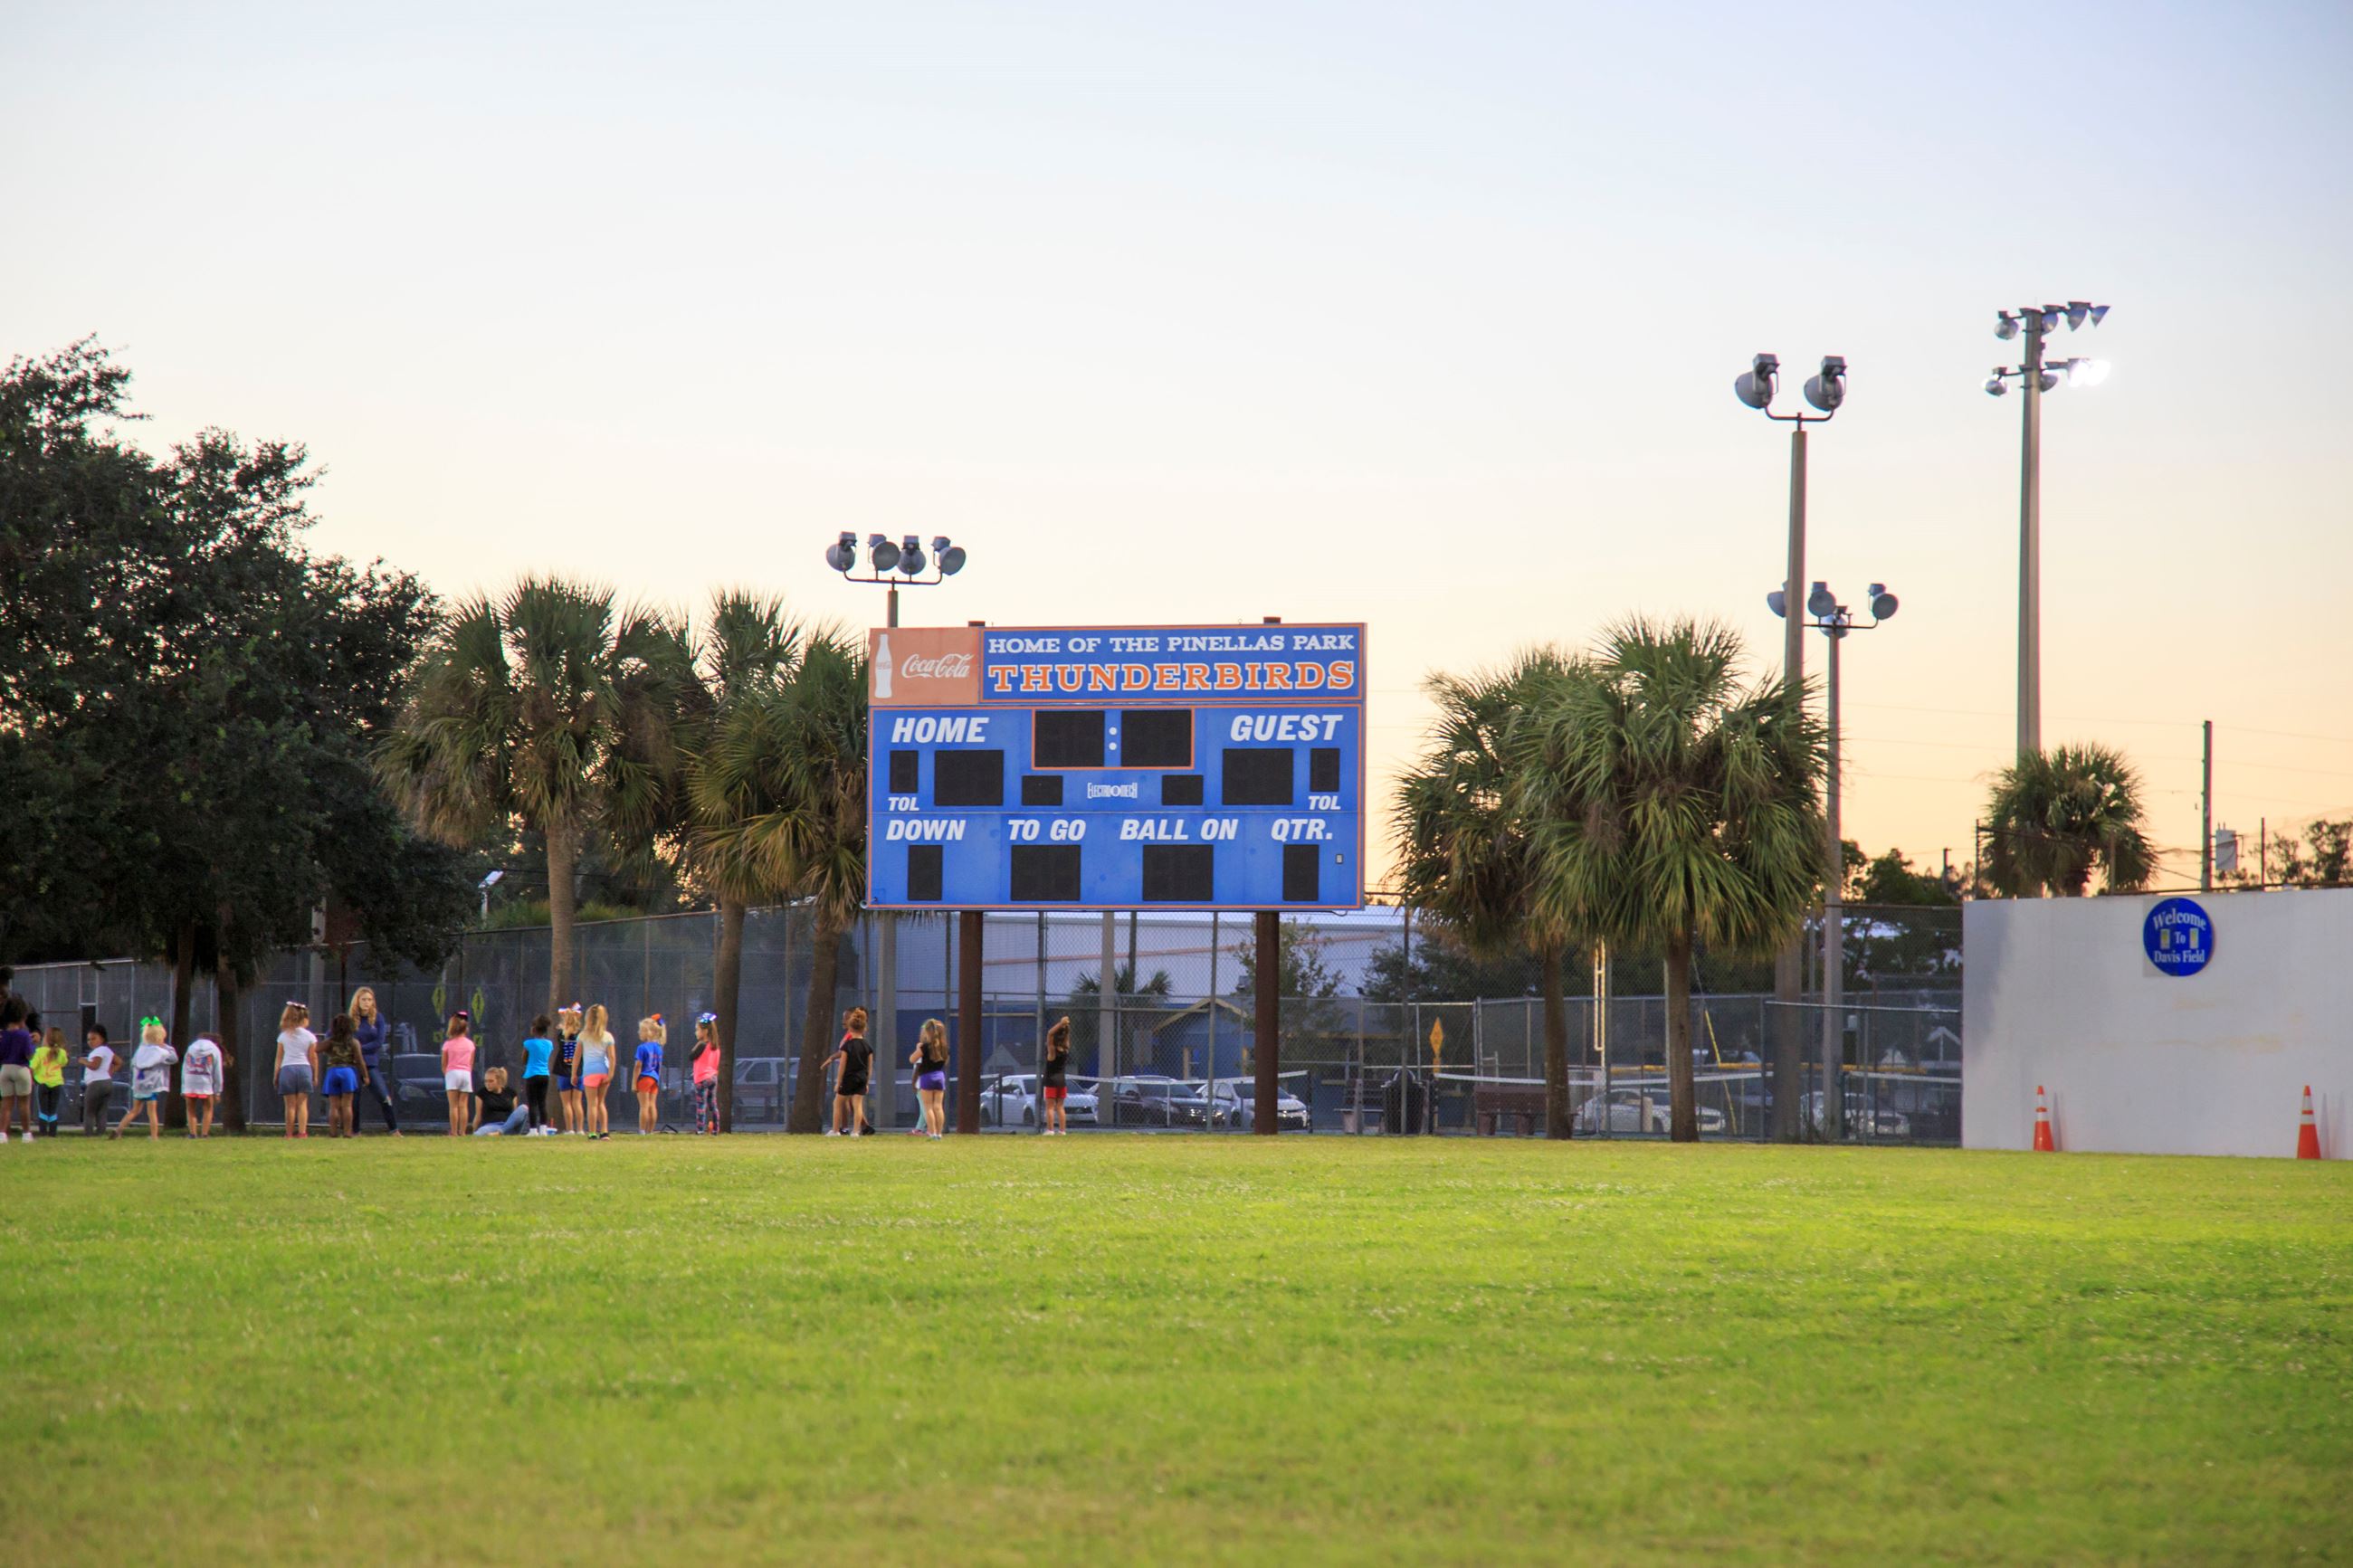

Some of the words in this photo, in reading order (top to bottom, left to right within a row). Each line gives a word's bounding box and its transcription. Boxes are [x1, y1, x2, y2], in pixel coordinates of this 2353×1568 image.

[988, 637, 1060, 653] HOME
[1068, 637, 1100, 652] OF
[1110, 637, 1159, 652] THE
[1167, 635, 1285, 651] PINELLAS
[1292, 634, 1355, 651] PARK
[988, 660, 1354, 692] THUNDERBIRDS
[891, 717, 989, 743] HOME
[1230, 714, 1344, 741] GUEST
[888, 796, 919, 812] TOL
[1308, 795, 1341, 810] TOL
[886, 819, 966, 841] DOWN
[1008, 819, 1040, 841] TO
[1050, 819, 1086, 841] GO
[1119, 819, 1189, 840] BALL
[1200, 819, 1239, 840] ON
[1271, 818, 1334, 842] QTR.
[2154, 908, 2205, 930] Welcome
[2175, 931, 2186, 944] To
[2154, 951, 2180, 963] Davis
[2183, 950, 2205, 963] Field
